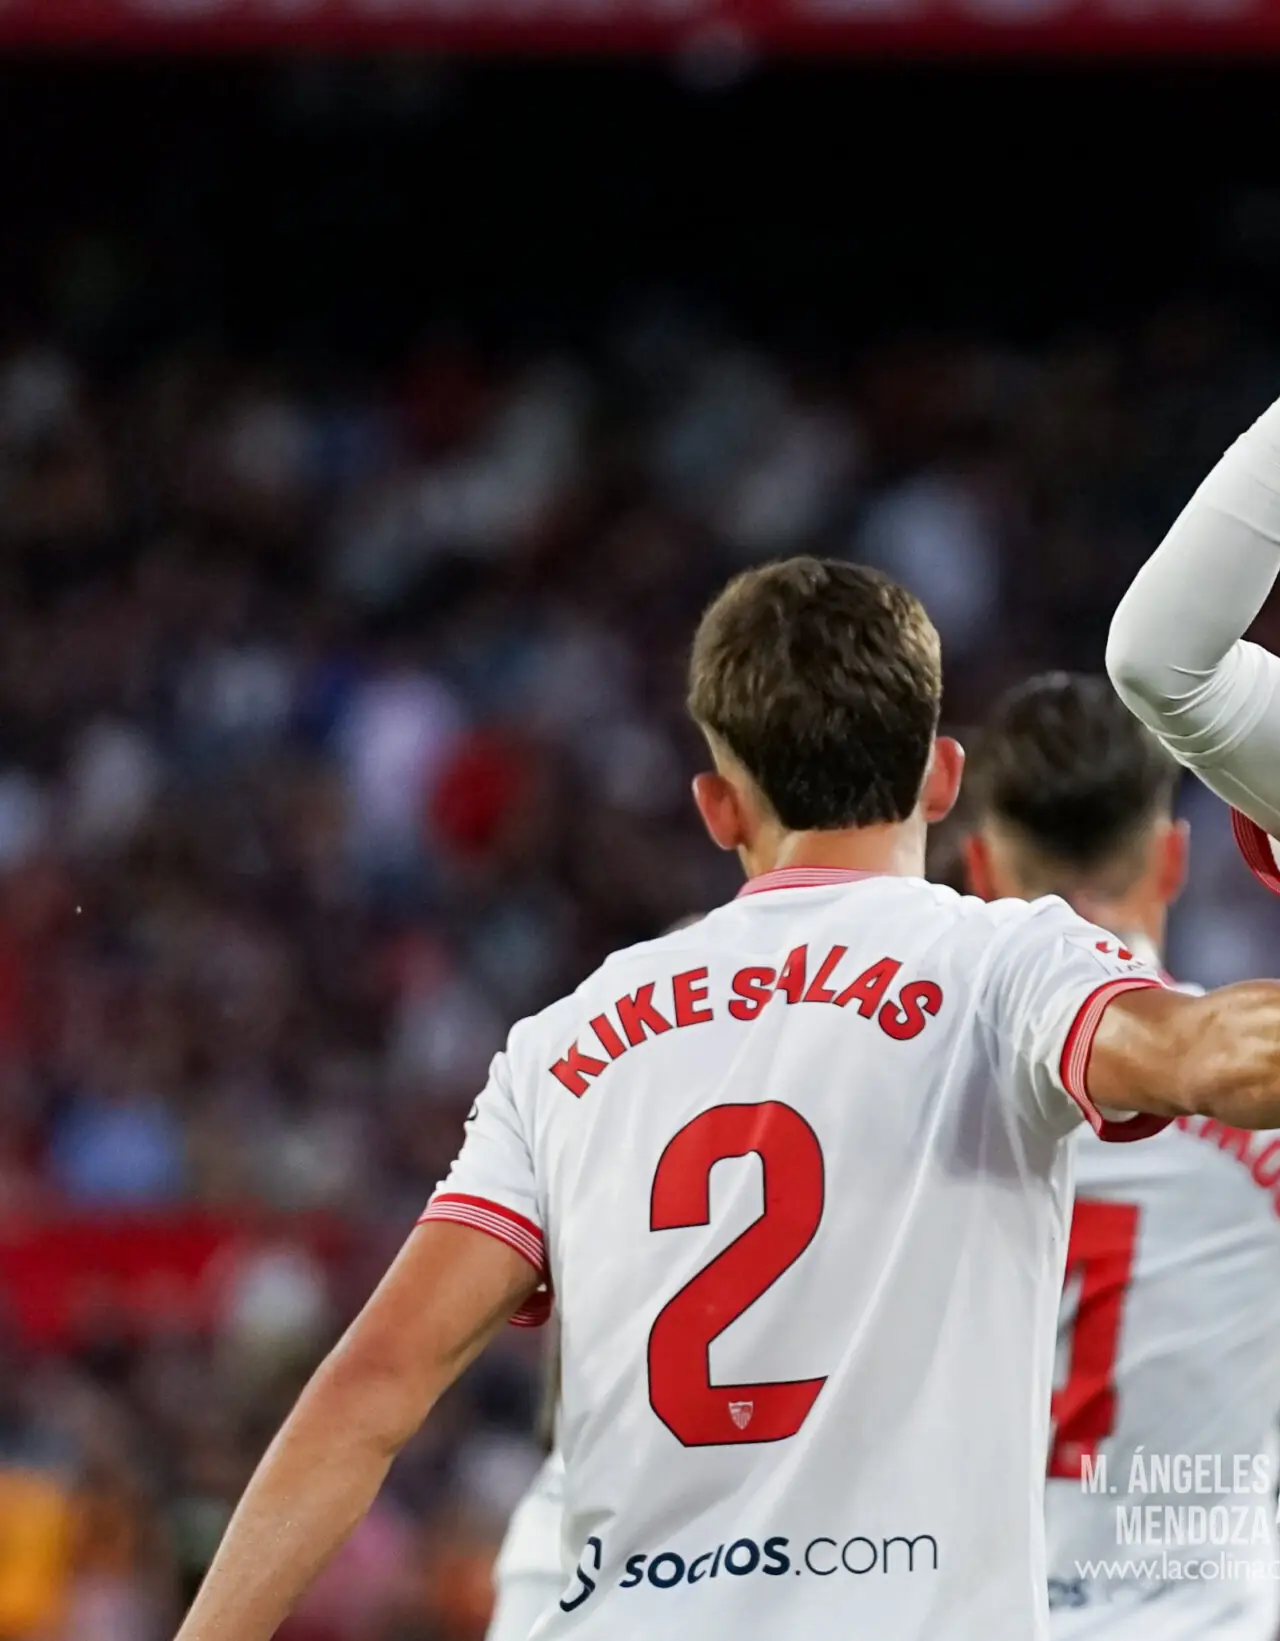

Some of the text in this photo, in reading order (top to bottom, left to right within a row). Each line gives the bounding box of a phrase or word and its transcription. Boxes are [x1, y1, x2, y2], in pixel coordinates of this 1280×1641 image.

[548, 943, 943, 1098] KIKE SALAS
[647, 1100, 828, 1447] 2
[619, 1534, 939, 1589] socios.com
